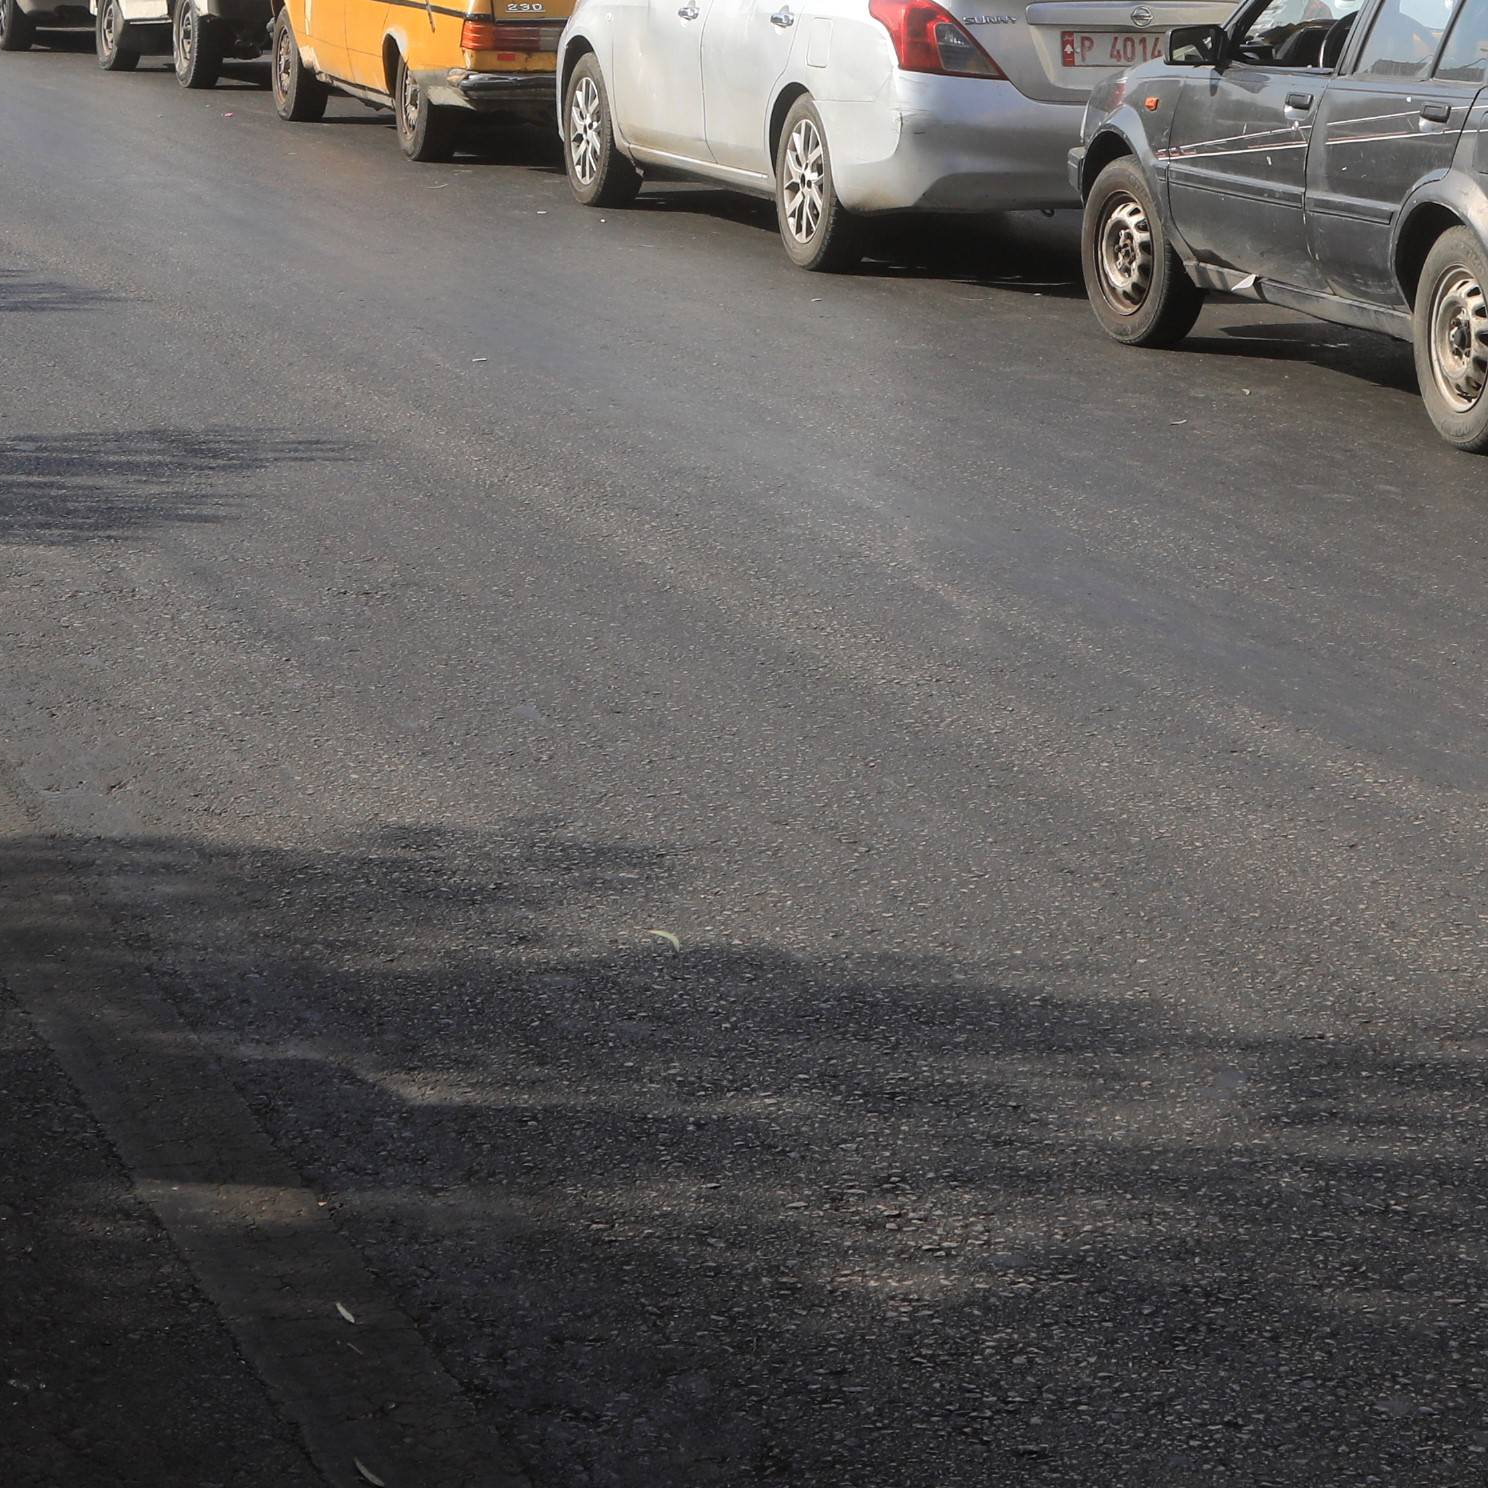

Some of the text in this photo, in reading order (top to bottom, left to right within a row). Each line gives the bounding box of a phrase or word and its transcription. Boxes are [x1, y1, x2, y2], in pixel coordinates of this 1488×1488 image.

[507, 3, 543, 11] 230
[962, 15, 1017, 25] SUNNY
[1080, 36, 1094, 62] P
